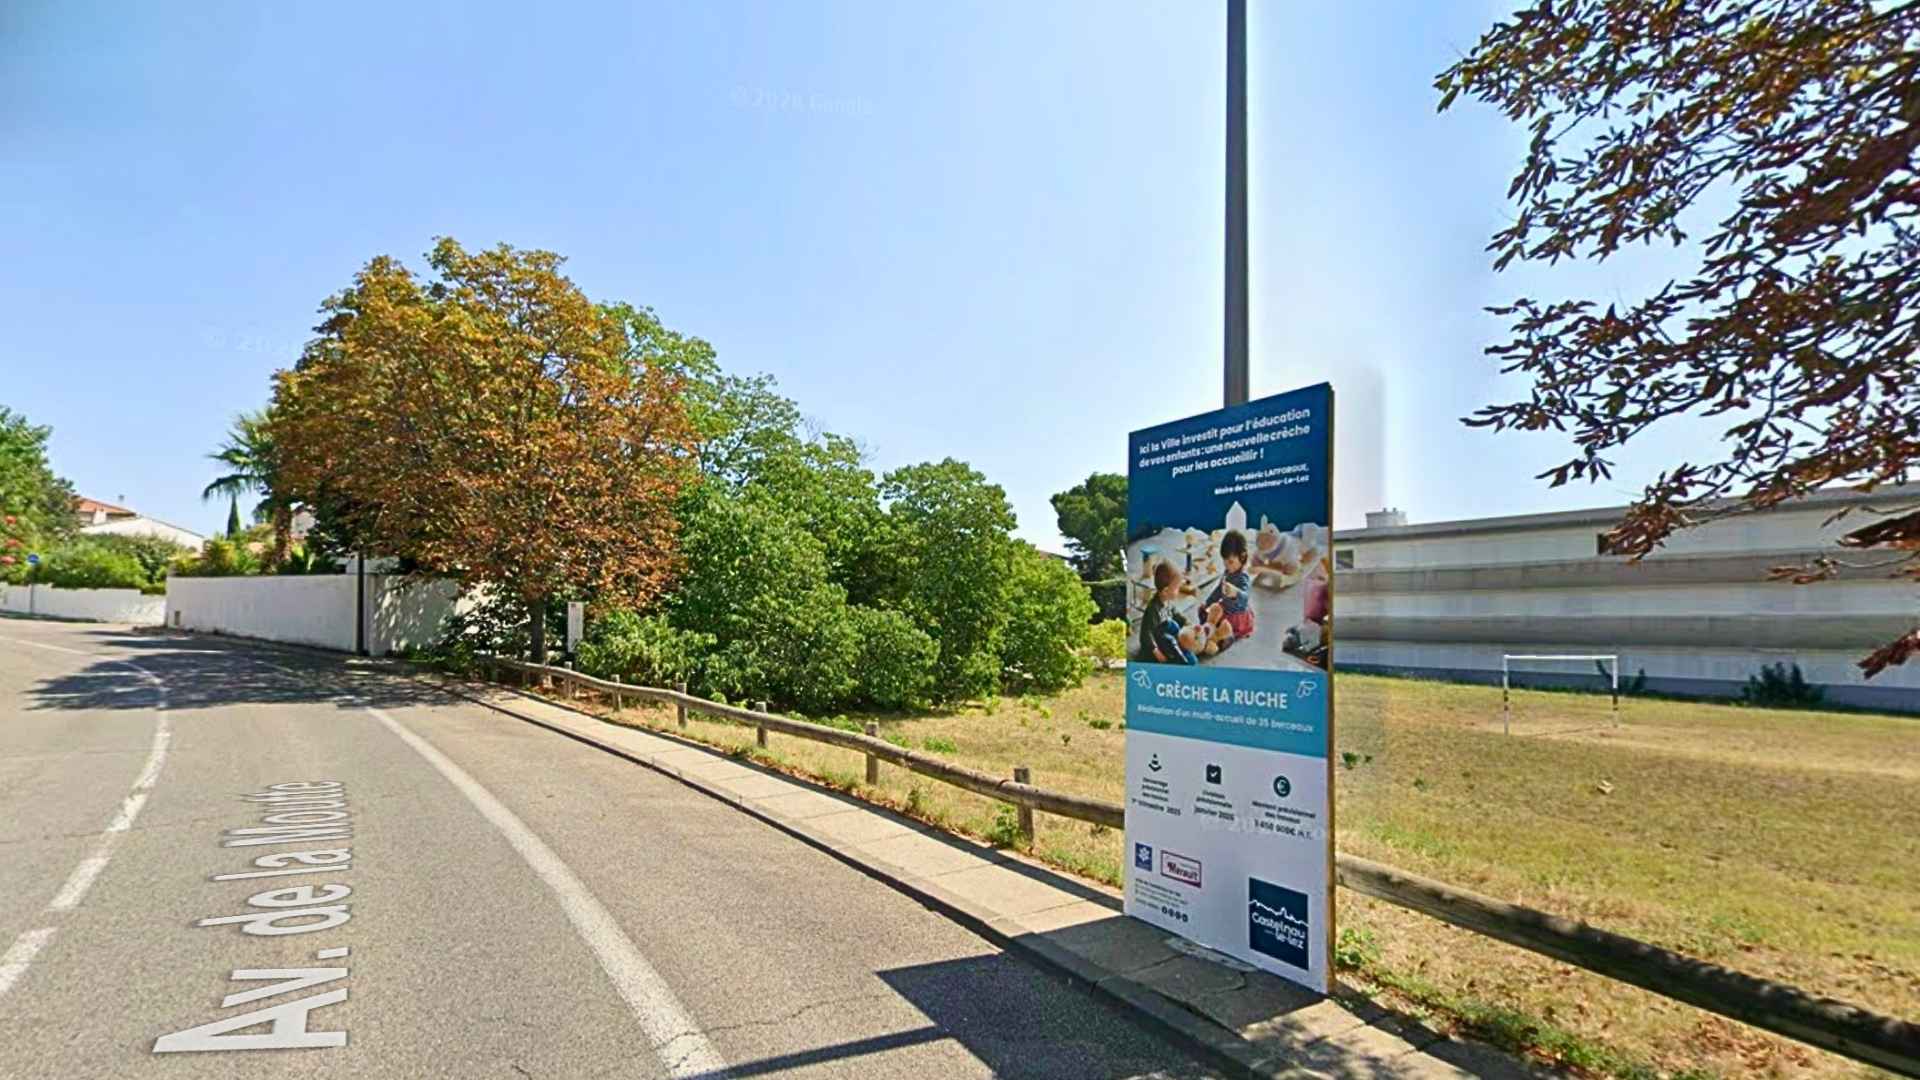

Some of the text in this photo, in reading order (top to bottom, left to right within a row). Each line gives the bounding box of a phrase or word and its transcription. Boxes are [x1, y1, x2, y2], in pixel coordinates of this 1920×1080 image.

[1139, 409, 1310, 454] Ici la Ville investit pour l'éducation
[1139, 459, 1149, 468] de
[1151, 456, 1166, 466] vos
[1205, 443, 1224, 454] une
[1224, 432, 1270, 450] nouvelle
[1270, 425, 1311, 441] crèche
[1172, 447, 1265, 479] pour les accueillir !
[1235, 484, 1243, 492] de
[1156, 680, 1288, 709] CRÈCHE LA RUCHE
[1137, 704, 1174, 716] Réalisation
[1246, 716, 1257, 726] de
[1271, 719, 1314, 733] berceaux
[1252, 912, 1306, 940] Castelnau
